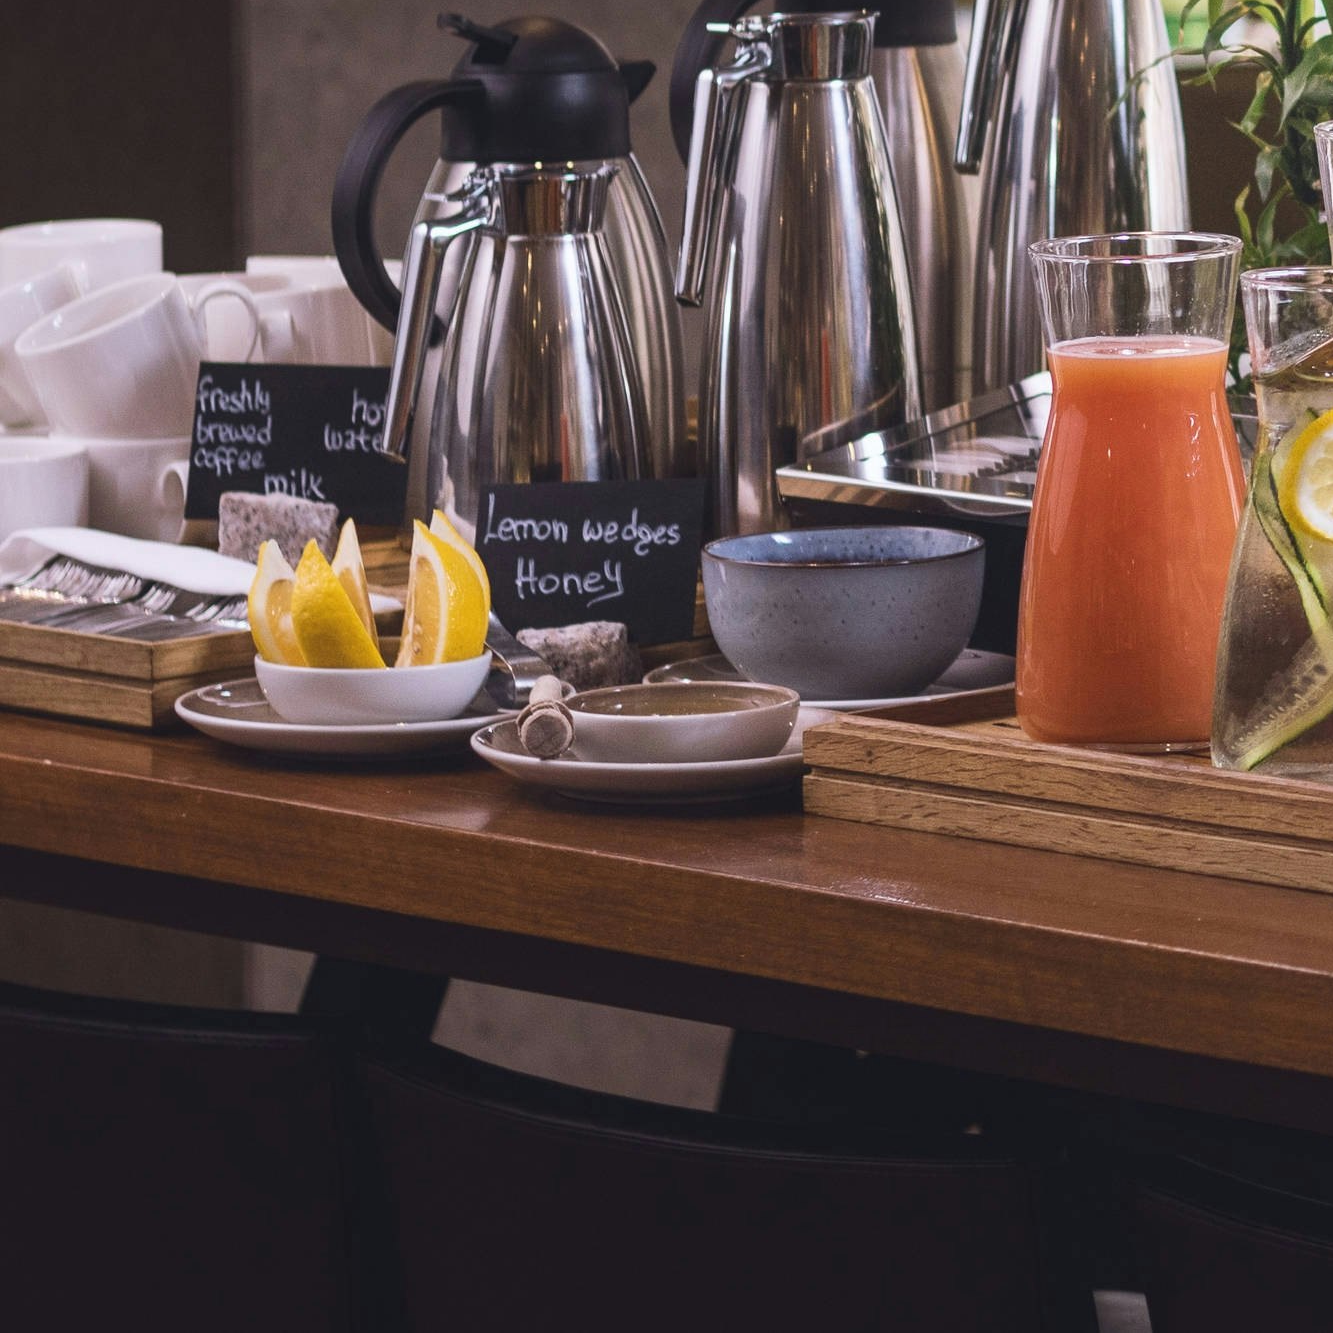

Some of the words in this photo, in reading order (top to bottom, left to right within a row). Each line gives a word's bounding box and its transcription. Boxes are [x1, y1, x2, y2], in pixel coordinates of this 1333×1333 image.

[199, 374, 271, 414] freshly
[196, 415, 272, 445] brewed
[323, 423, 385, 453] wate
[193, 446, 266, 477] coffee
[264, 467, 326, 500] milk
[484, 492, 568, 545] Lemon
[582, 507, 681, 556] wedges
[515, 556, 624, 608] Honey
